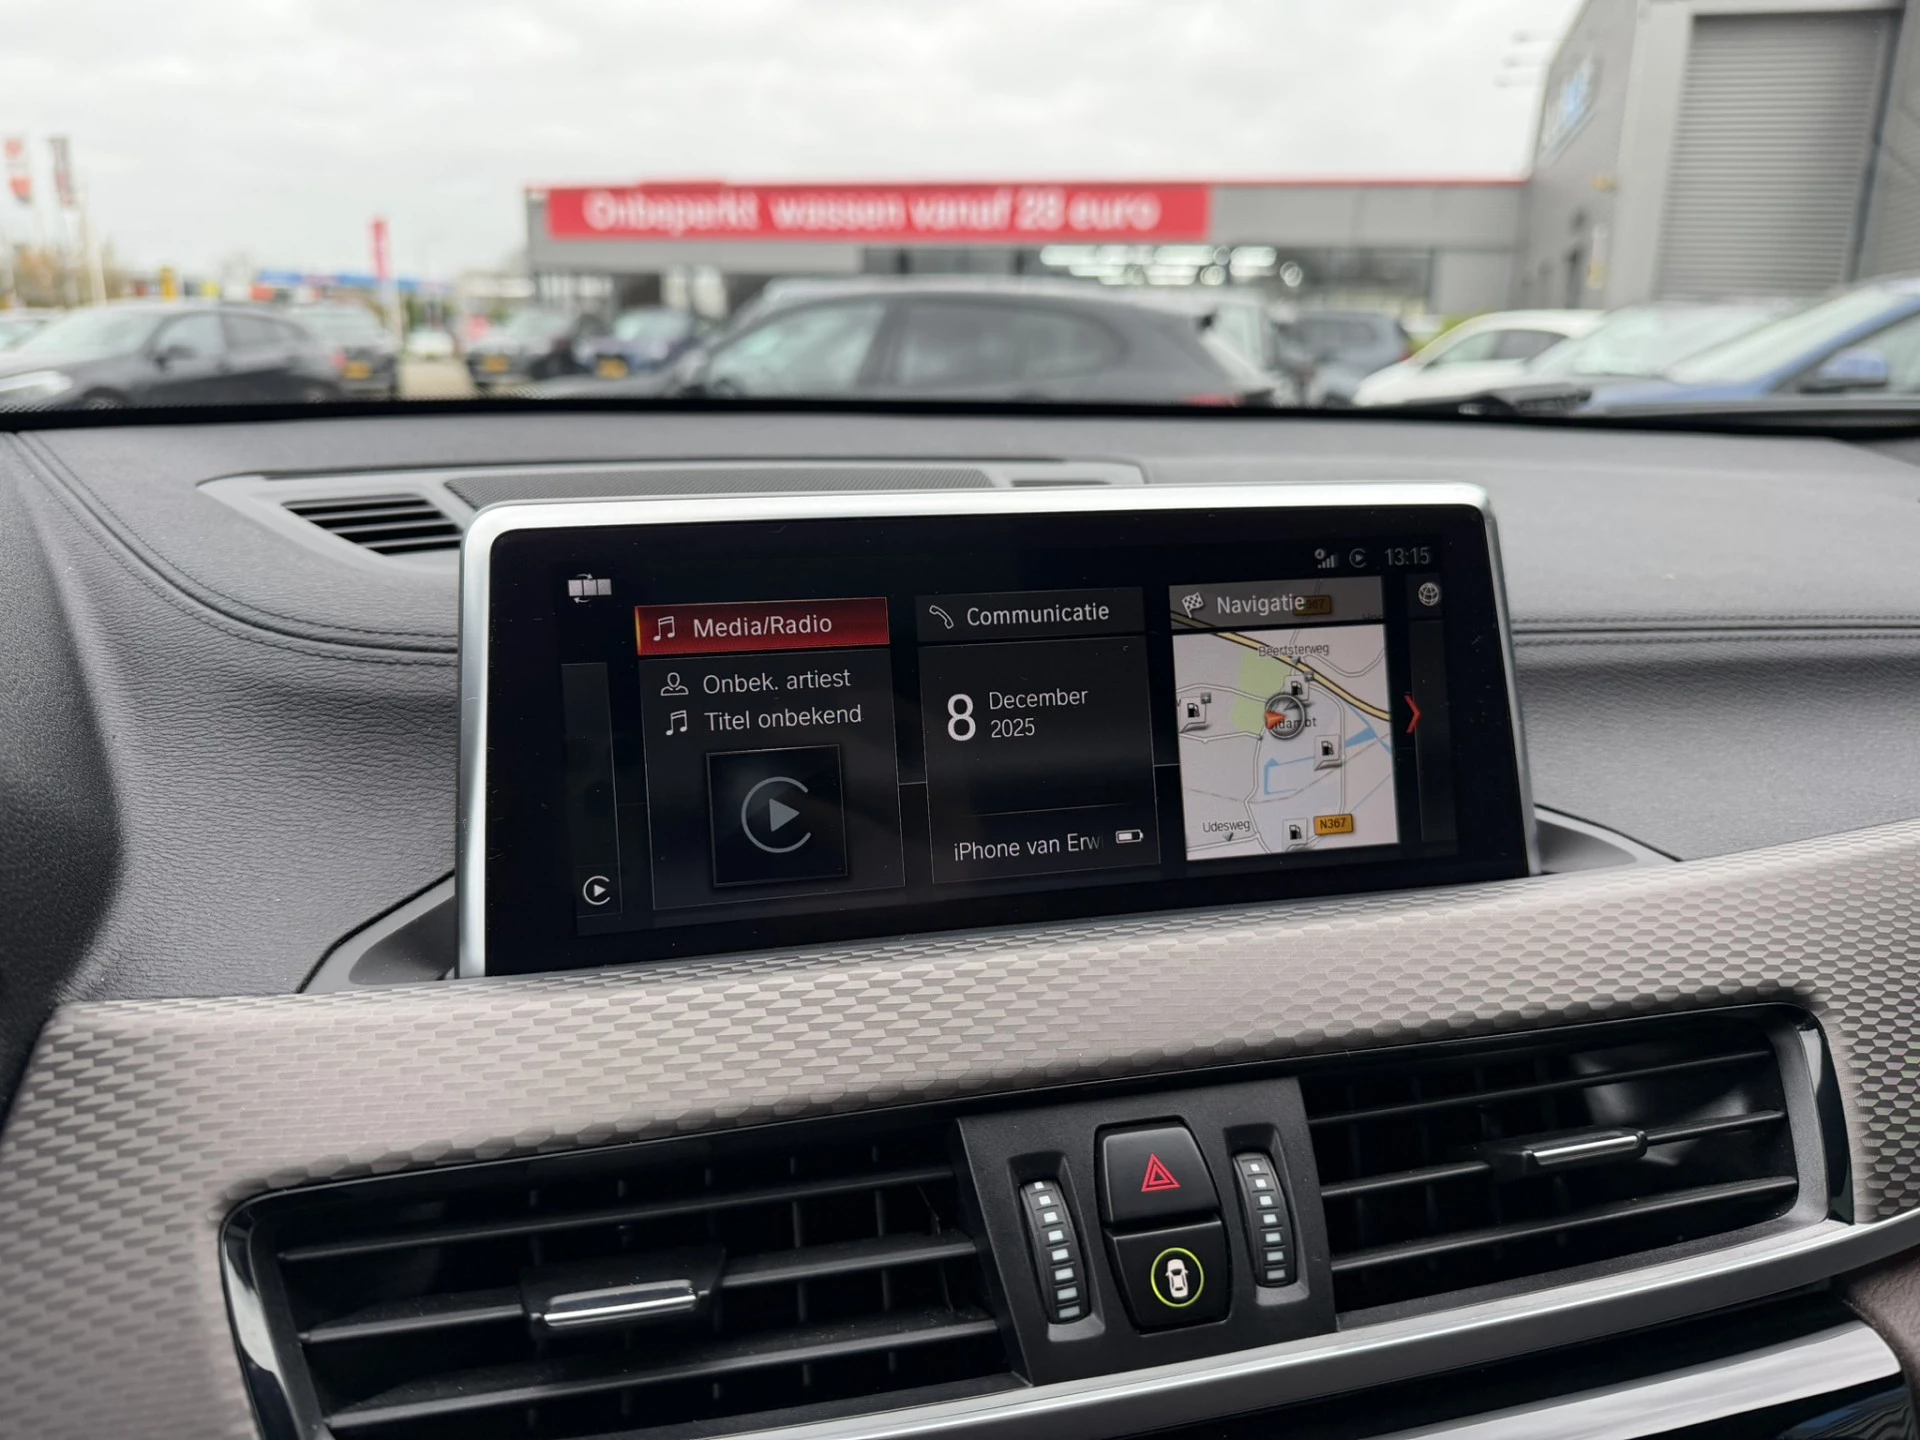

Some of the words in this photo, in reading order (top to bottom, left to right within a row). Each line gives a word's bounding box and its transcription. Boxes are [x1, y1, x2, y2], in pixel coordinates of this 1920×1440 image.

[769, 194, 906, 231] wassen
[1066, 192, 1161, 231] euro
[1384, 546, 1430, 565] 13:15
[966, 602, 1110, 626] Communicatie
[1216, 594, 1305, 616] Navigatie
[692, 614, 833, 638] Media/Radio
[703, 672, 779, 695] Onbek.
[786, 669, 852, 690] artiest
[989, 688, 1089, 710] December
[704, 711, 751, 732] Titel
[758, 704, 863, 729] onbekend
[947, 693, 977, 741] 8
[990, 718, 1036, 738] 2025
[1202, 820, 1250, 833] Udesweg
[1319, 817, 1347, 830] N367
[954, 842, 1021, 862] iPhone
[1026, 838, 1060, 855] van
